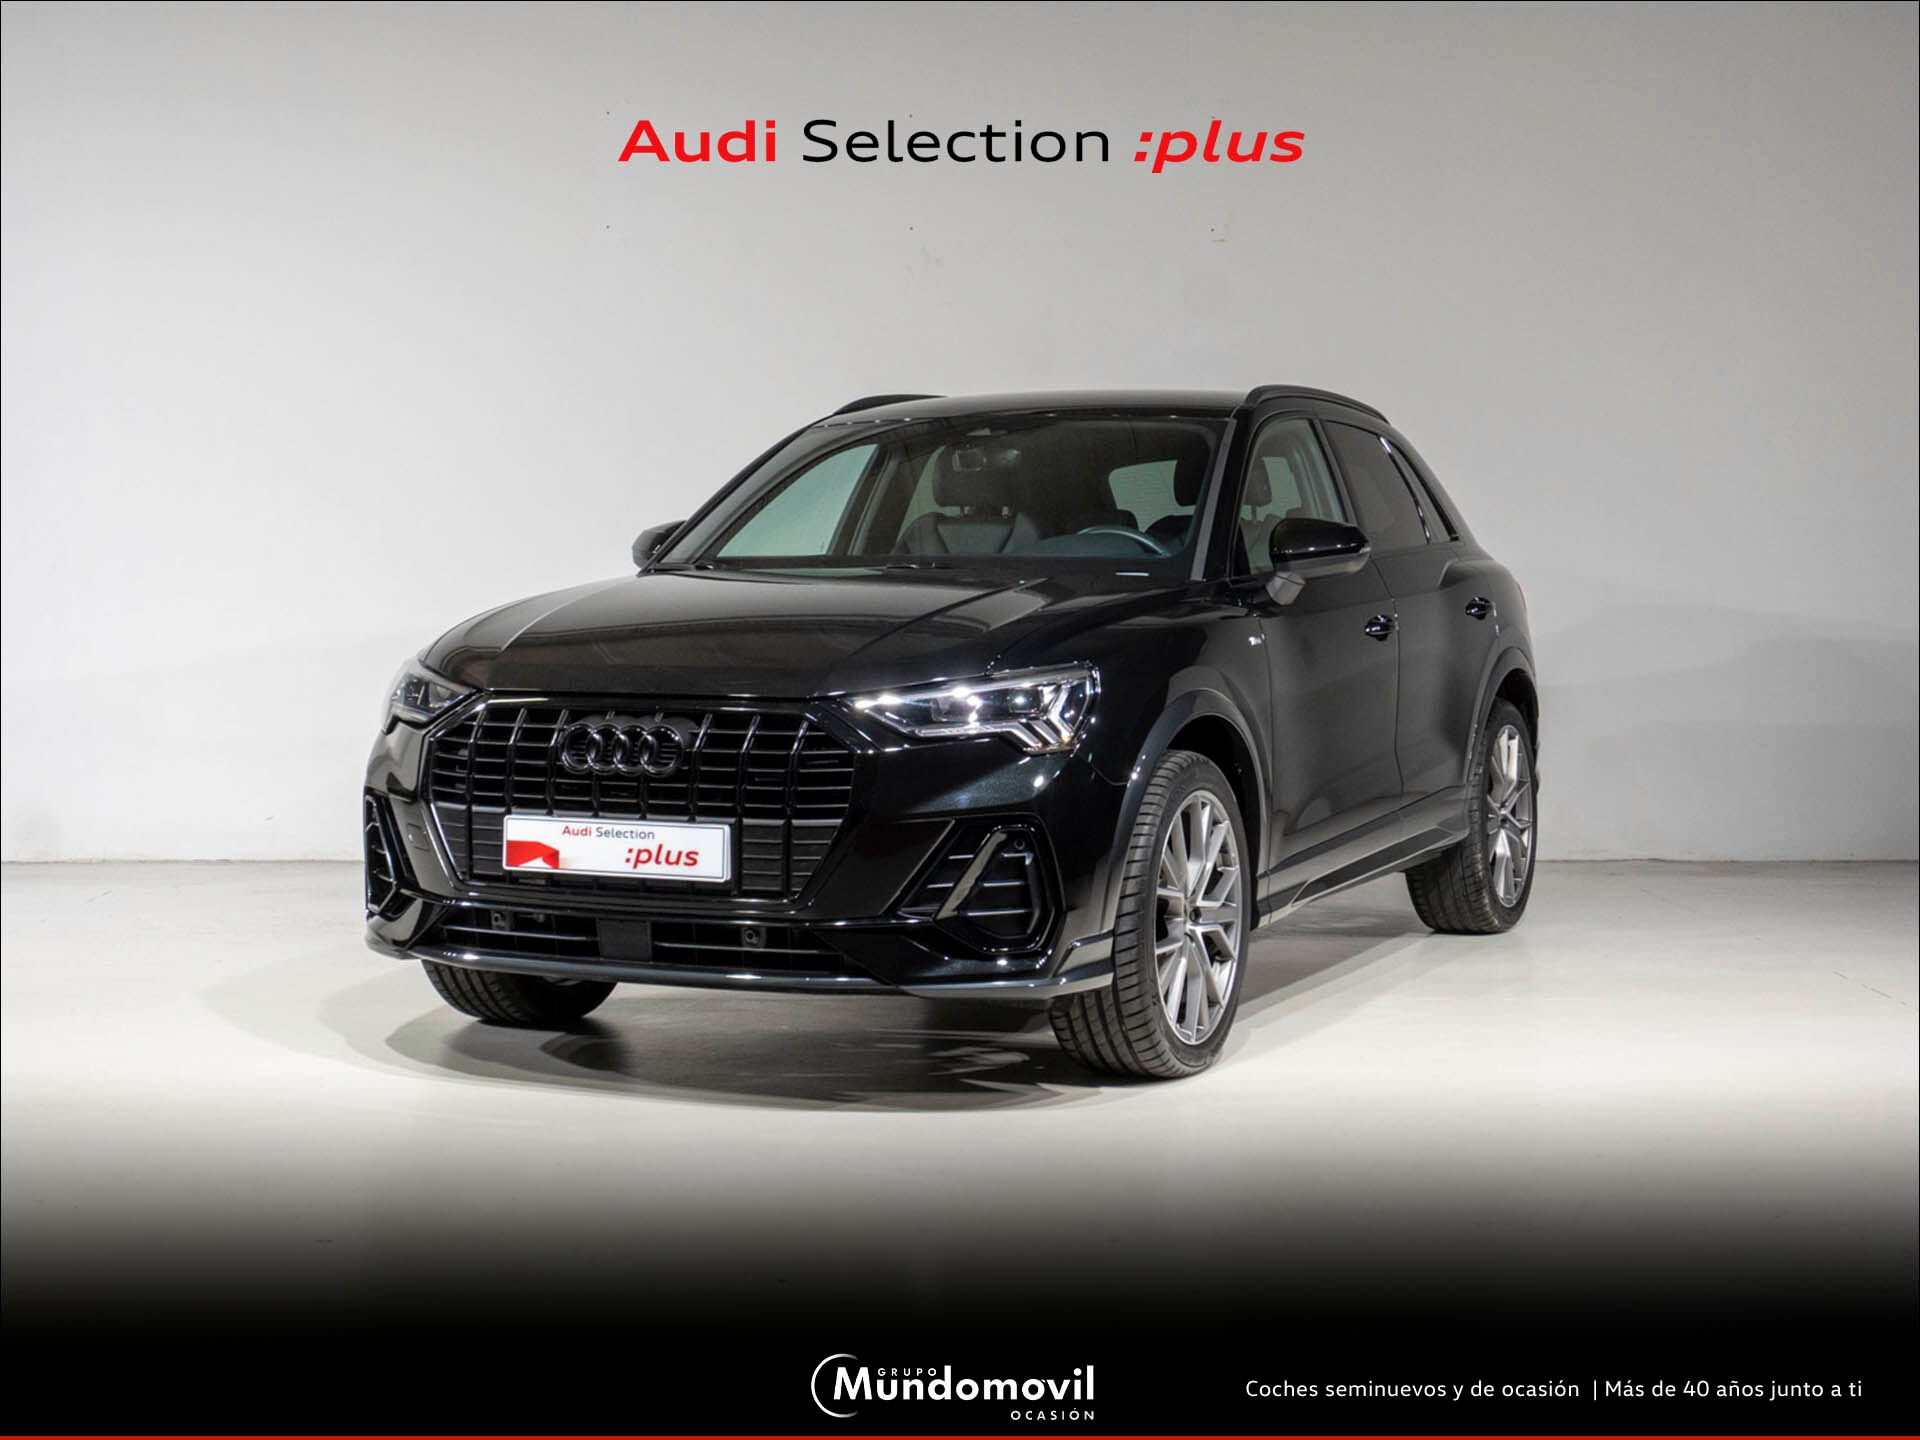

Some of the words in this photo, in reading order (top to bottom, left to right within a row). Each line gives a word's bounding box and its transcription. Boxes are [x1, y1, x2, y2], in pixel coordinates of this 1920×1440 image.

[562, 826, 592, 837] Audi
[595, 827, 655, 840] Selection
[625, 844, 699, 869] :plus
